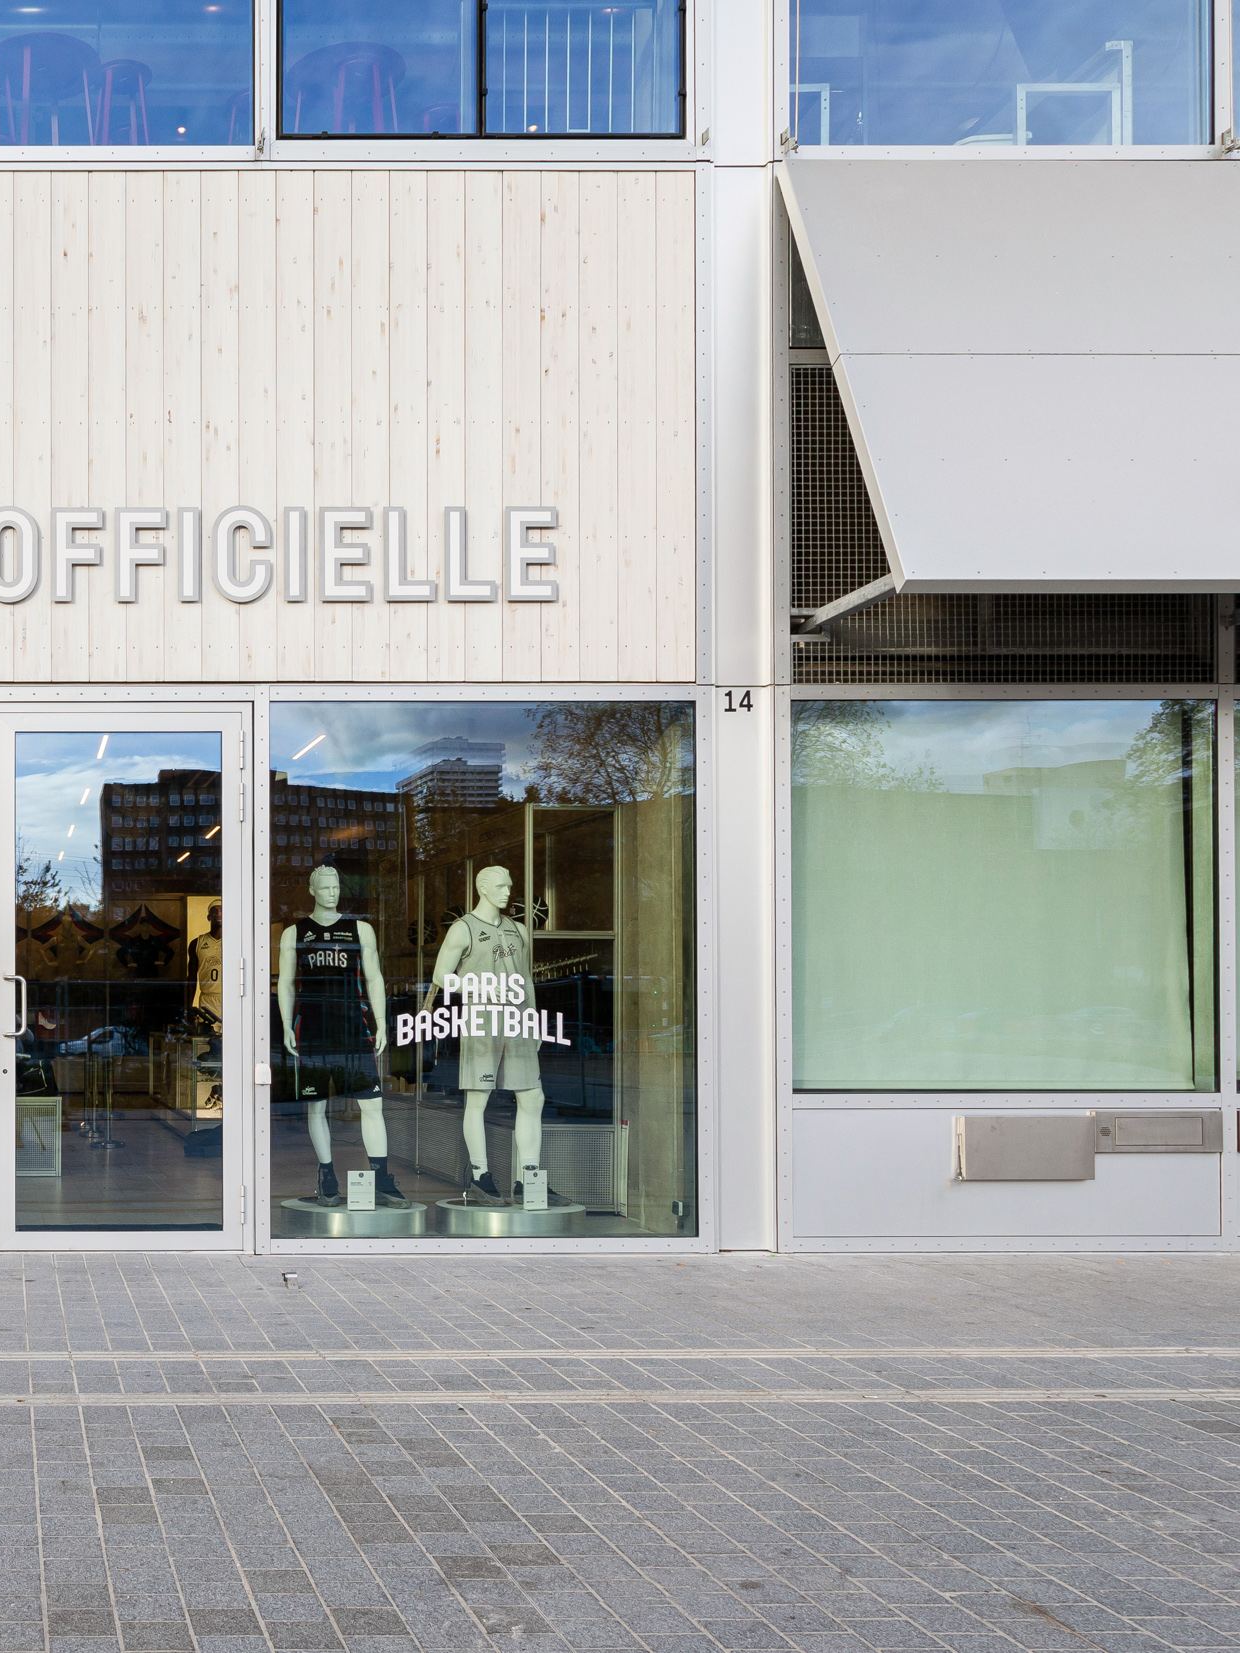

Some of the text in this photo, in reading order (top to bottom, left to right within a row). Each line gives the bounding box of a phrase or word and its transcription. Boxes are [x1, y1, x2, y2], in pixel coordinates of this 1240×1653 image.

[724, 690, 753, 712] 14
[308, 950, 348, 969] PARIS
[211, 968, 219, 982] 0
[443, 972, 525, 1006] PARIS
[397, 1005, 571, 1046] BASKETBALL
